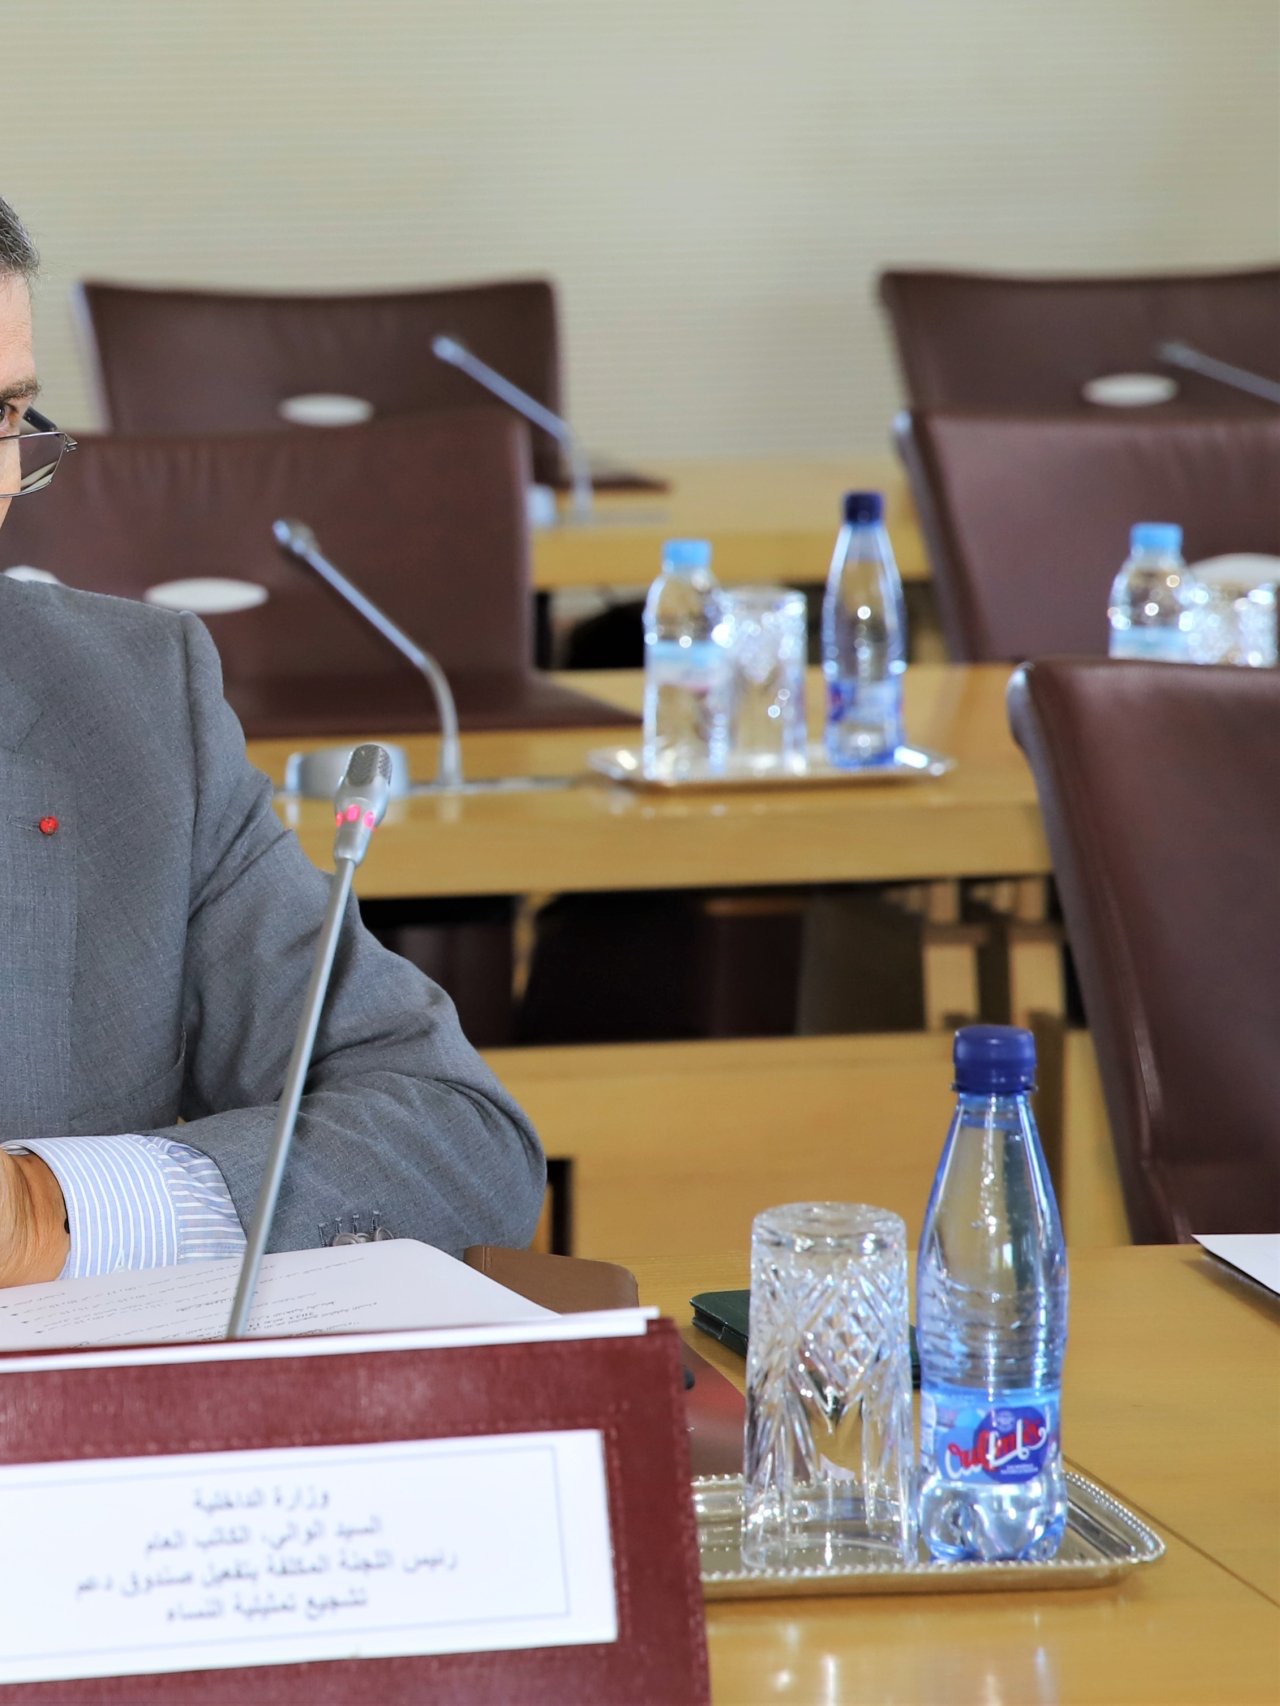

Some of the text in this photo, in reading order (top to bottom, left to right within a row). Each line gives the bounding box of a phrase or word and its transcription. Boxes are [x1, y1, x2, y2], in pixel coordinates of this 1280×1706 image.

[193, 1486, 330, 1515] وزارة الداخلية
[194, 1525, 251, 1550] الكاتب
[336, 1514, 382, 1541] السيد
[145, 1529, 185, 1556] العام
[76, 1549, 458, 1600] رئيس اللجنة المكلفة بتفعيل صندوق دعم
[166, 1598, 224, 1623] النساء
[233, 1593, 297, 1621] تمثيلية
